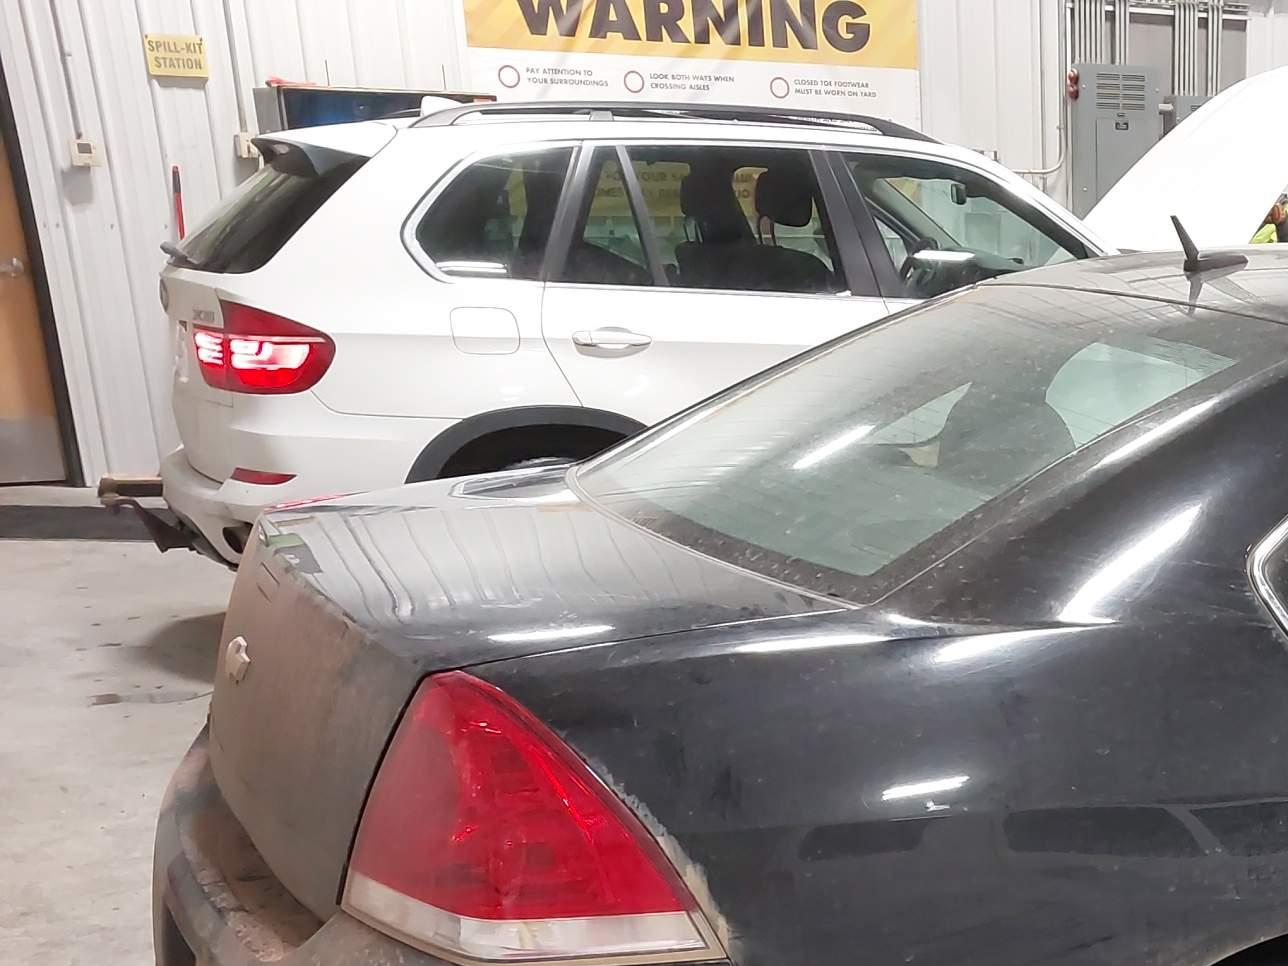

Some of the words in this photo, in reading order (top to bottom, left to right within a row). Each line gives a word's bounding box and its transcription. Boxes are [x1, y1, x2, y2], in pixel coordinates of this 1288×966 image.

[516, 0, 871, 52] WARNING
[147, 40, 203, 54] SPILL-KIT
[154, 56, 202, 70] STATION
[542, 68, 582, 76] ATTENTION
[583, 69, 593, 77] TO
[527, 77, 549, 85] YOUR
[550, 78, 609, 87] SURROUNDINGS
[692, 74, 713, 82] WAYS
[713, 75, 735, 83] WHEN
[834, 80, 869, 88] FOOTWEAR
[823, 89, 846, 97] WORN
[847, 90, 859, 98] ON
